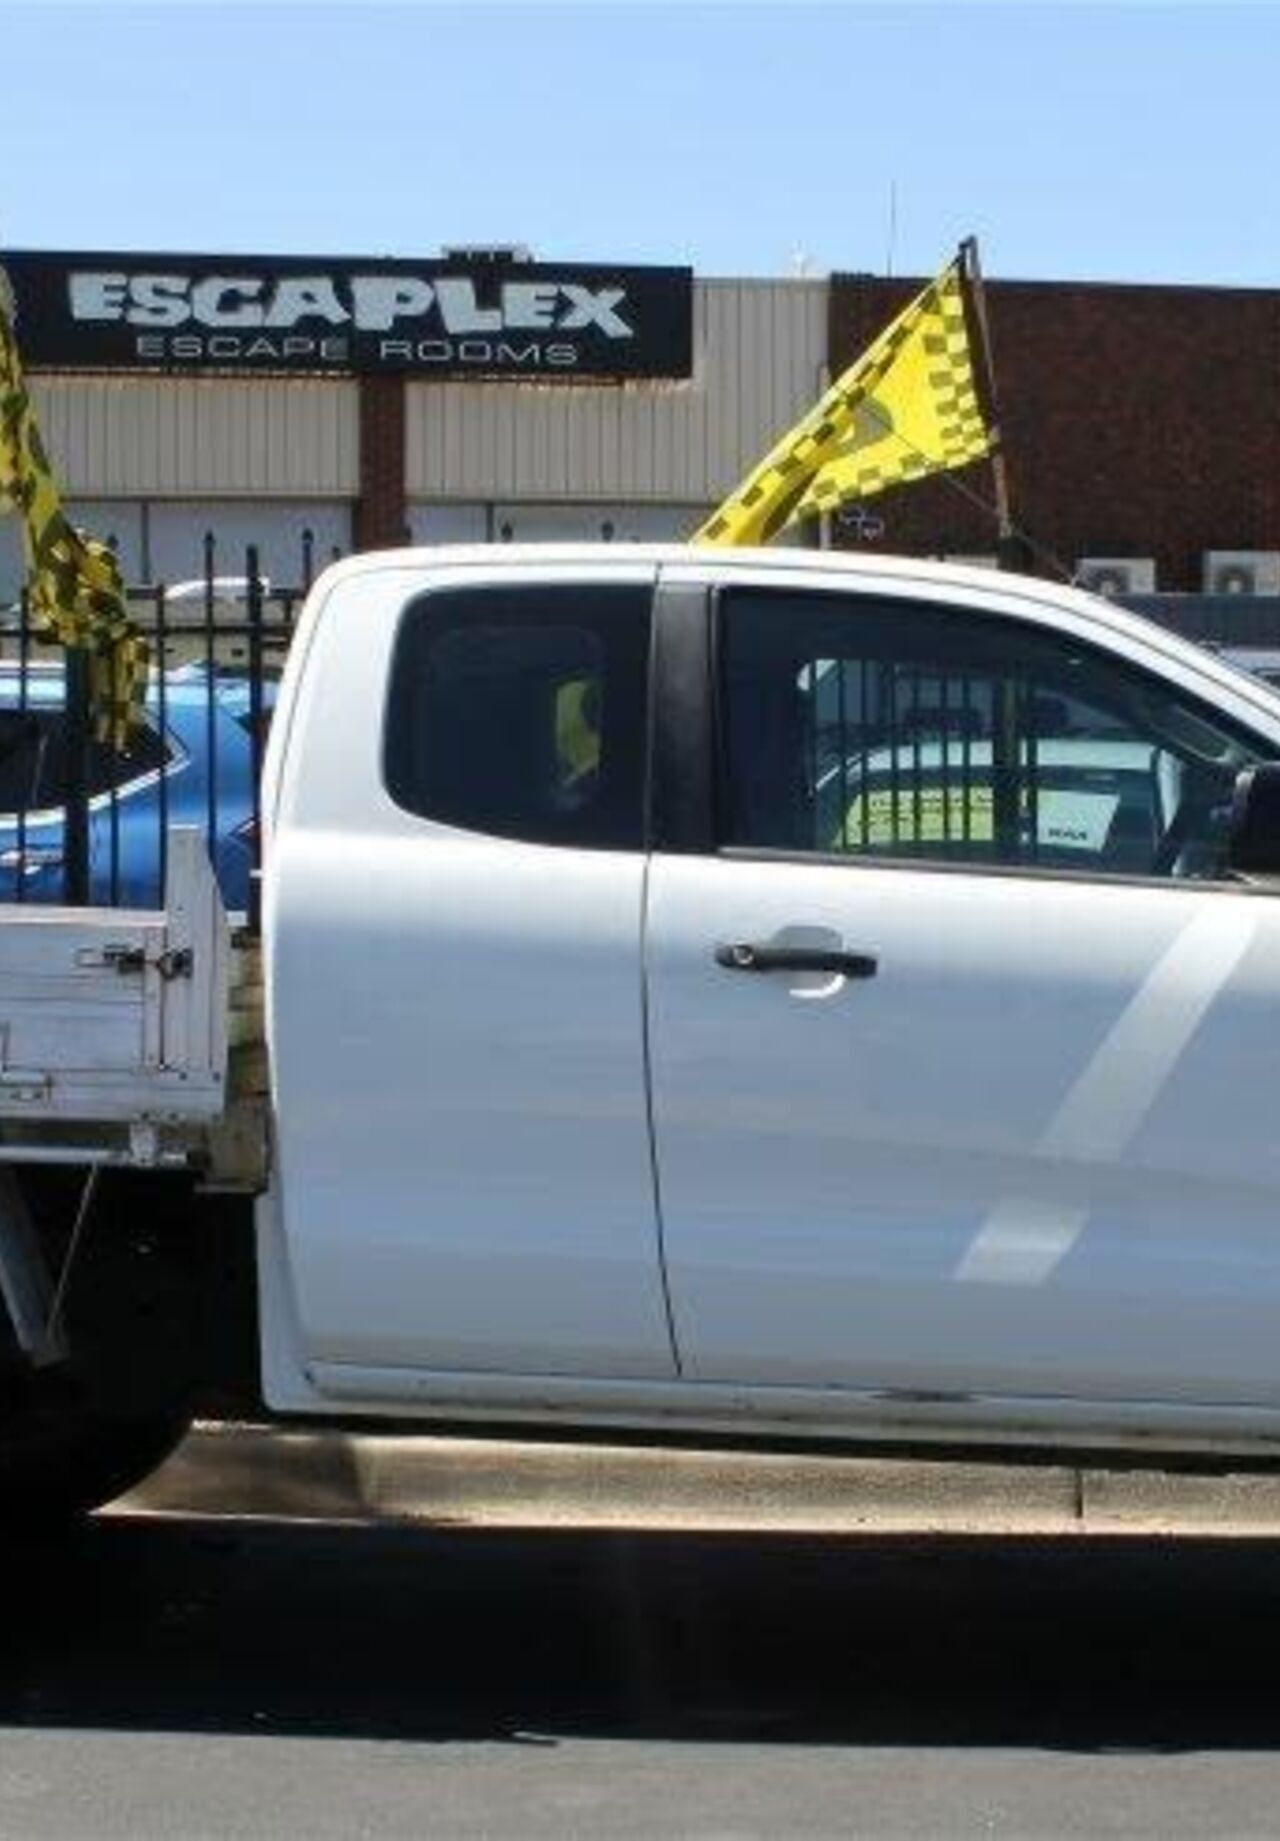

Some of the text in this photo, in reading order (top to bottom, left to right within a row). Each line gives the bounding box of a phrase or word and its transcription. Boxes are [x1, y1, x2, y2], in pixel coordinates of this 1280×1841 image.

[67, 272, 634, 338] ESCAPLEX
[135, 335, 578, 365] ESCAPE ROOMS
